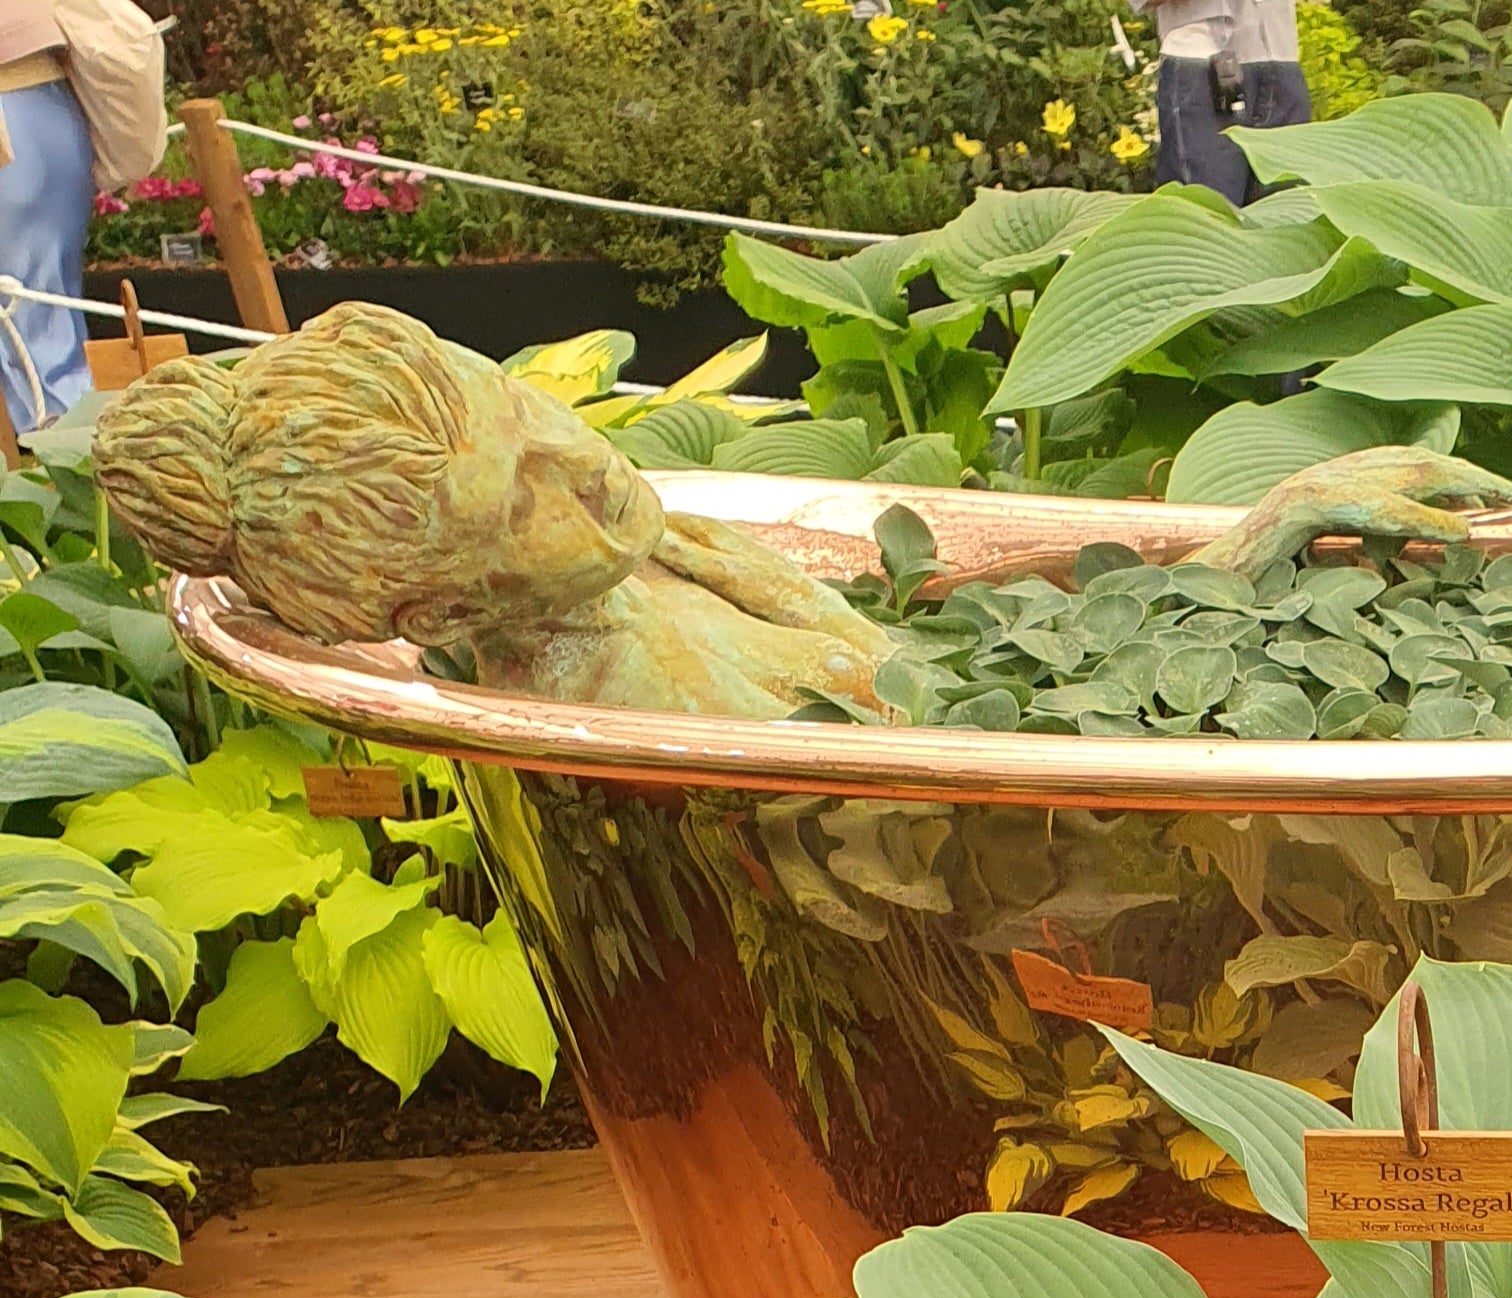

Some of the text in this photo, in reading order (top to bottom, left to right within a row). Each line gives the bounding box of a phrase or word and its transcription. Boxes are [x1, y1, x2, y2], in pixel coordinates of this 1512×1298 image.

[1379, 1162, 1463, 1182] Hosta
[1323, 1188, 1426, 1212] 'Krossa
[1361, 1221, 1485, 1232] New Forest Hostas
